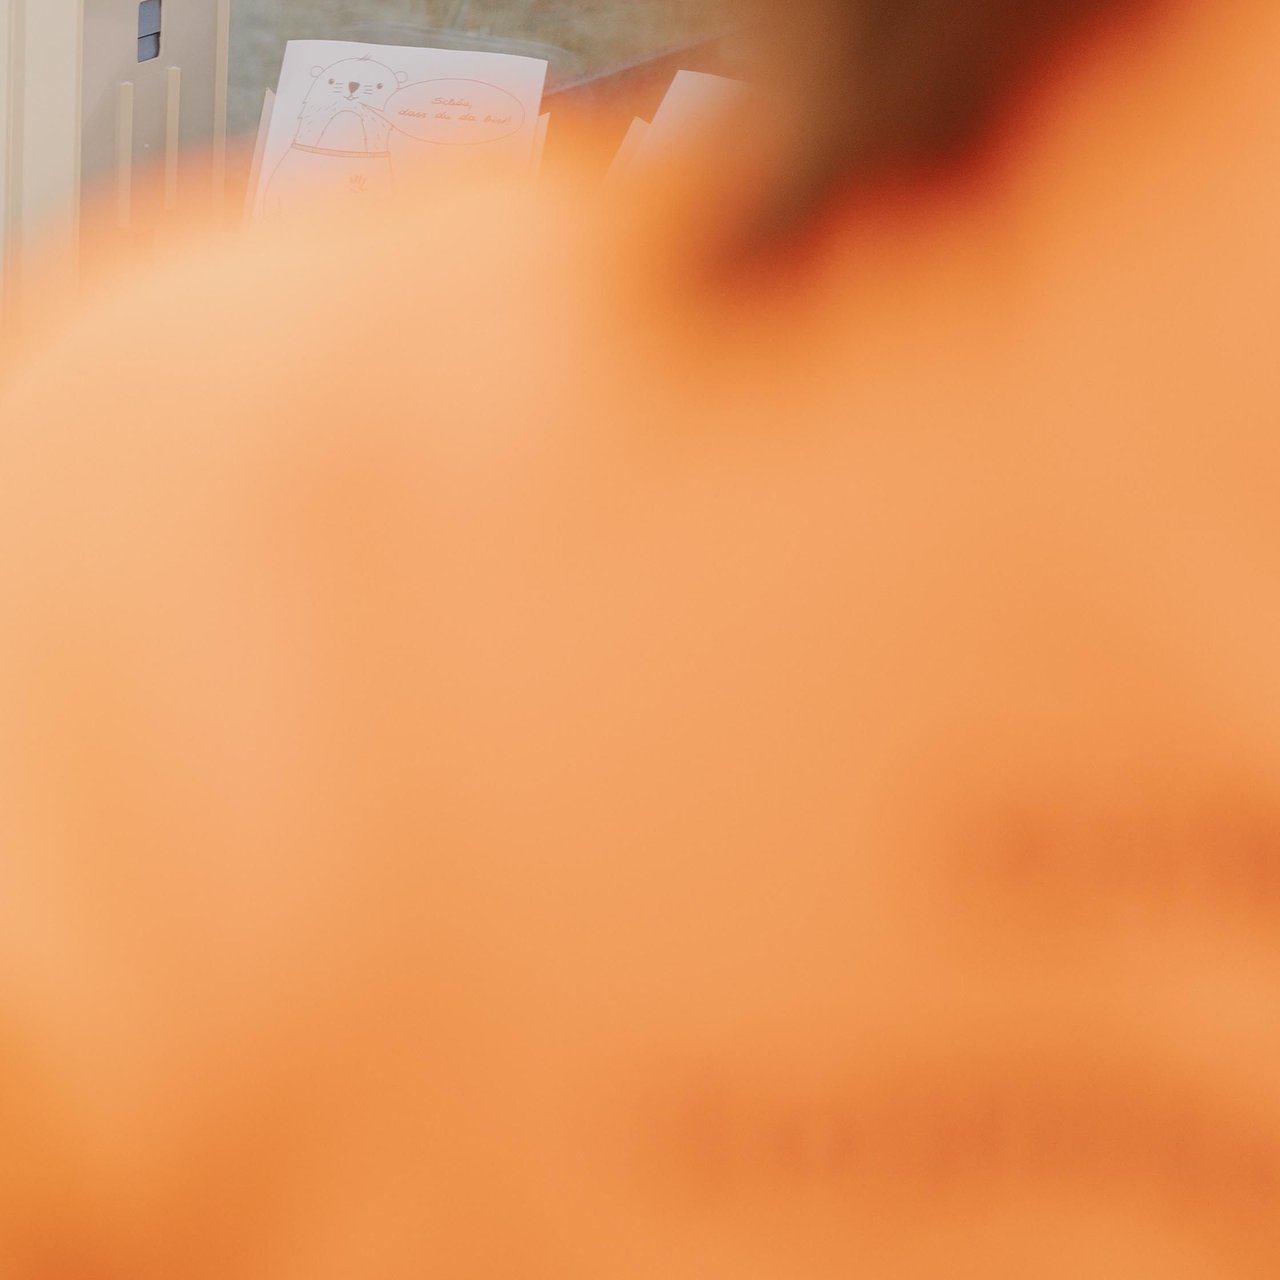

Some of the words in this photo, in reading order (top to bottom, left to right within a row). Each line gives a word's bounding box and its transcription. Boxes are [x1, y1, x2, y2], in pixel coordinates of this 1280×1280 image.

[399, 108, 426, 118] dass
[434, 111, 451, 120] du
[459, 112, 476, 121] da
